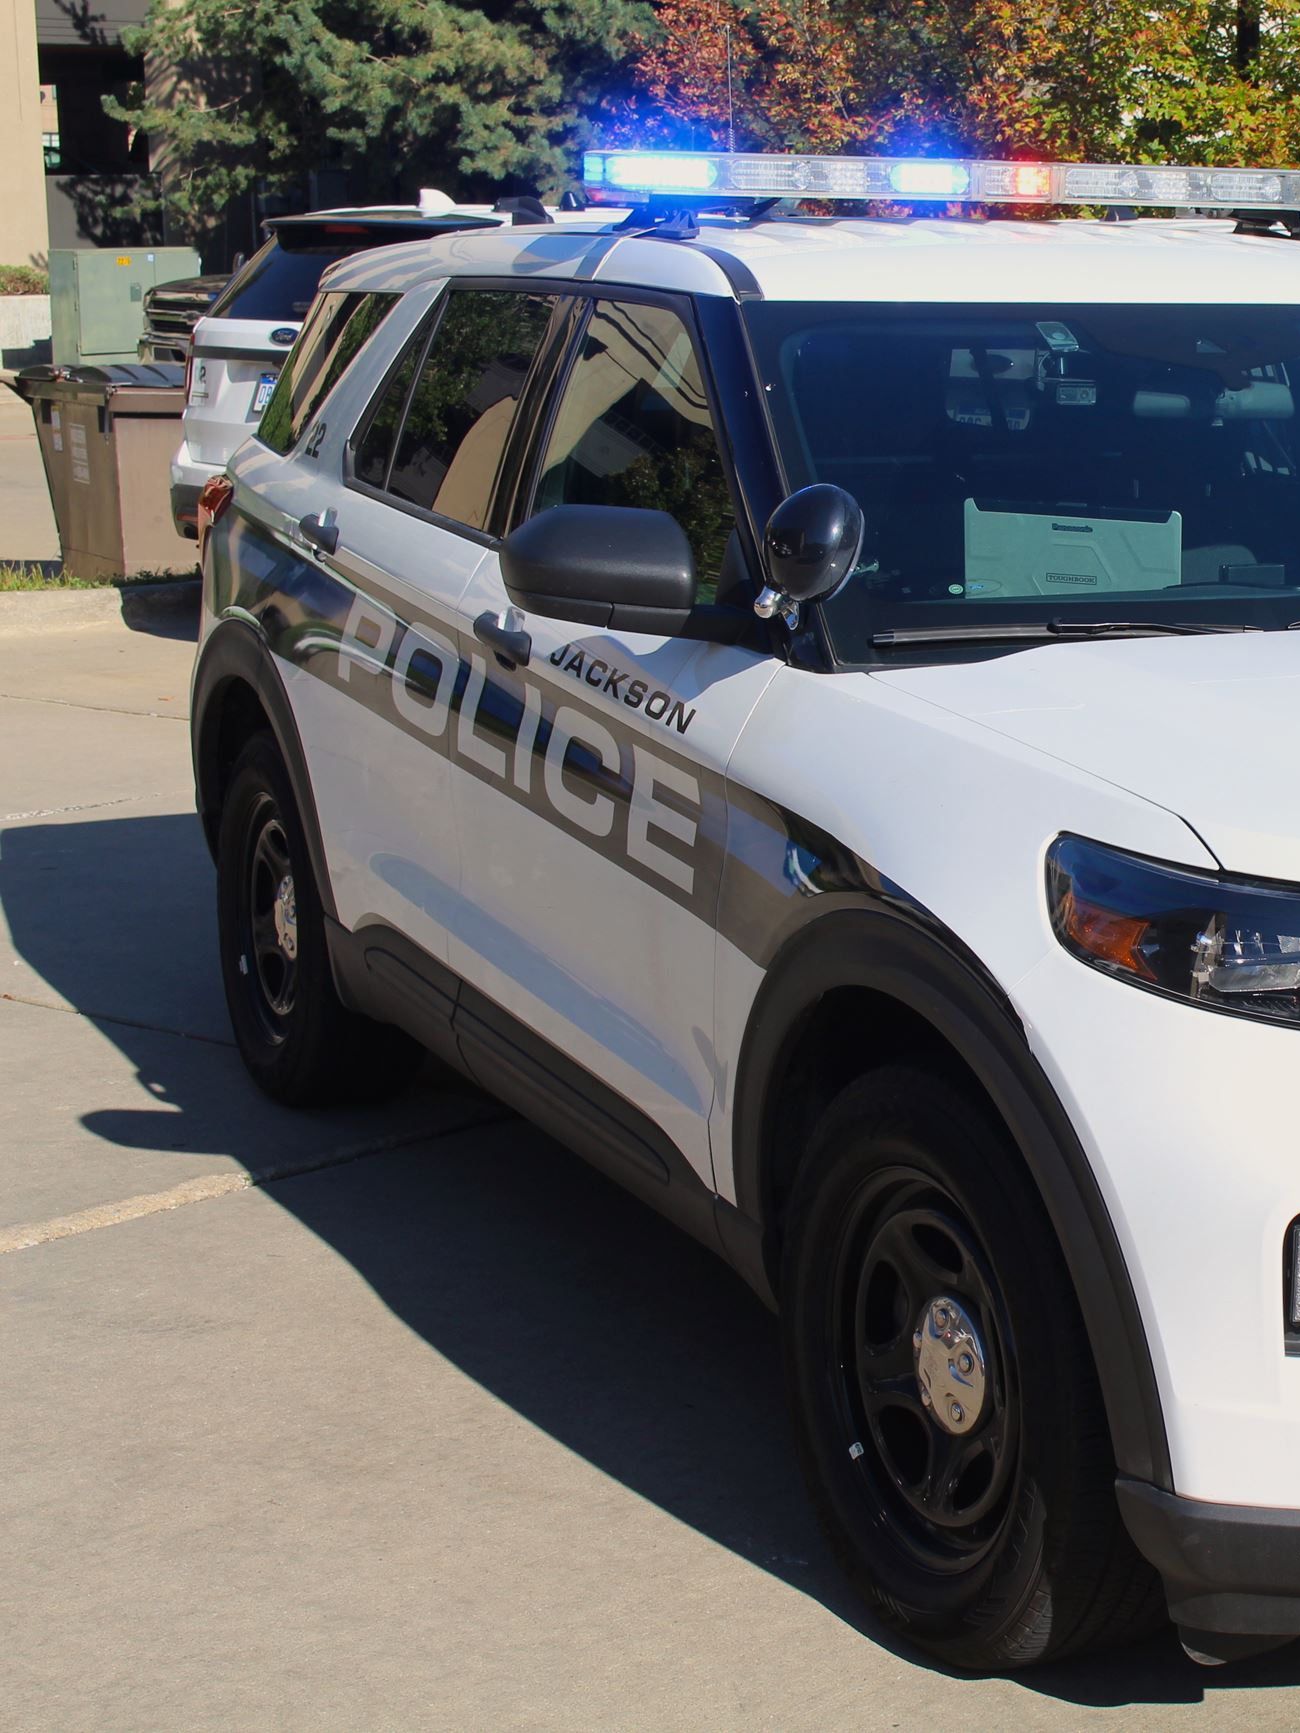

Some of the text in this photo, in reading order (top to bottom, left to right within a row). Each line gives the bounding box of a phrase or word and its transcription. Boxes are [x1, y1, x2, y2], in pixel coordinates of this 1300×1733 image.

[1048, 574, 1095, 584] TOUGHBOOK
[549, 643, 697, 735] JACKSON
[337, 590, 702, 895] POLICE
